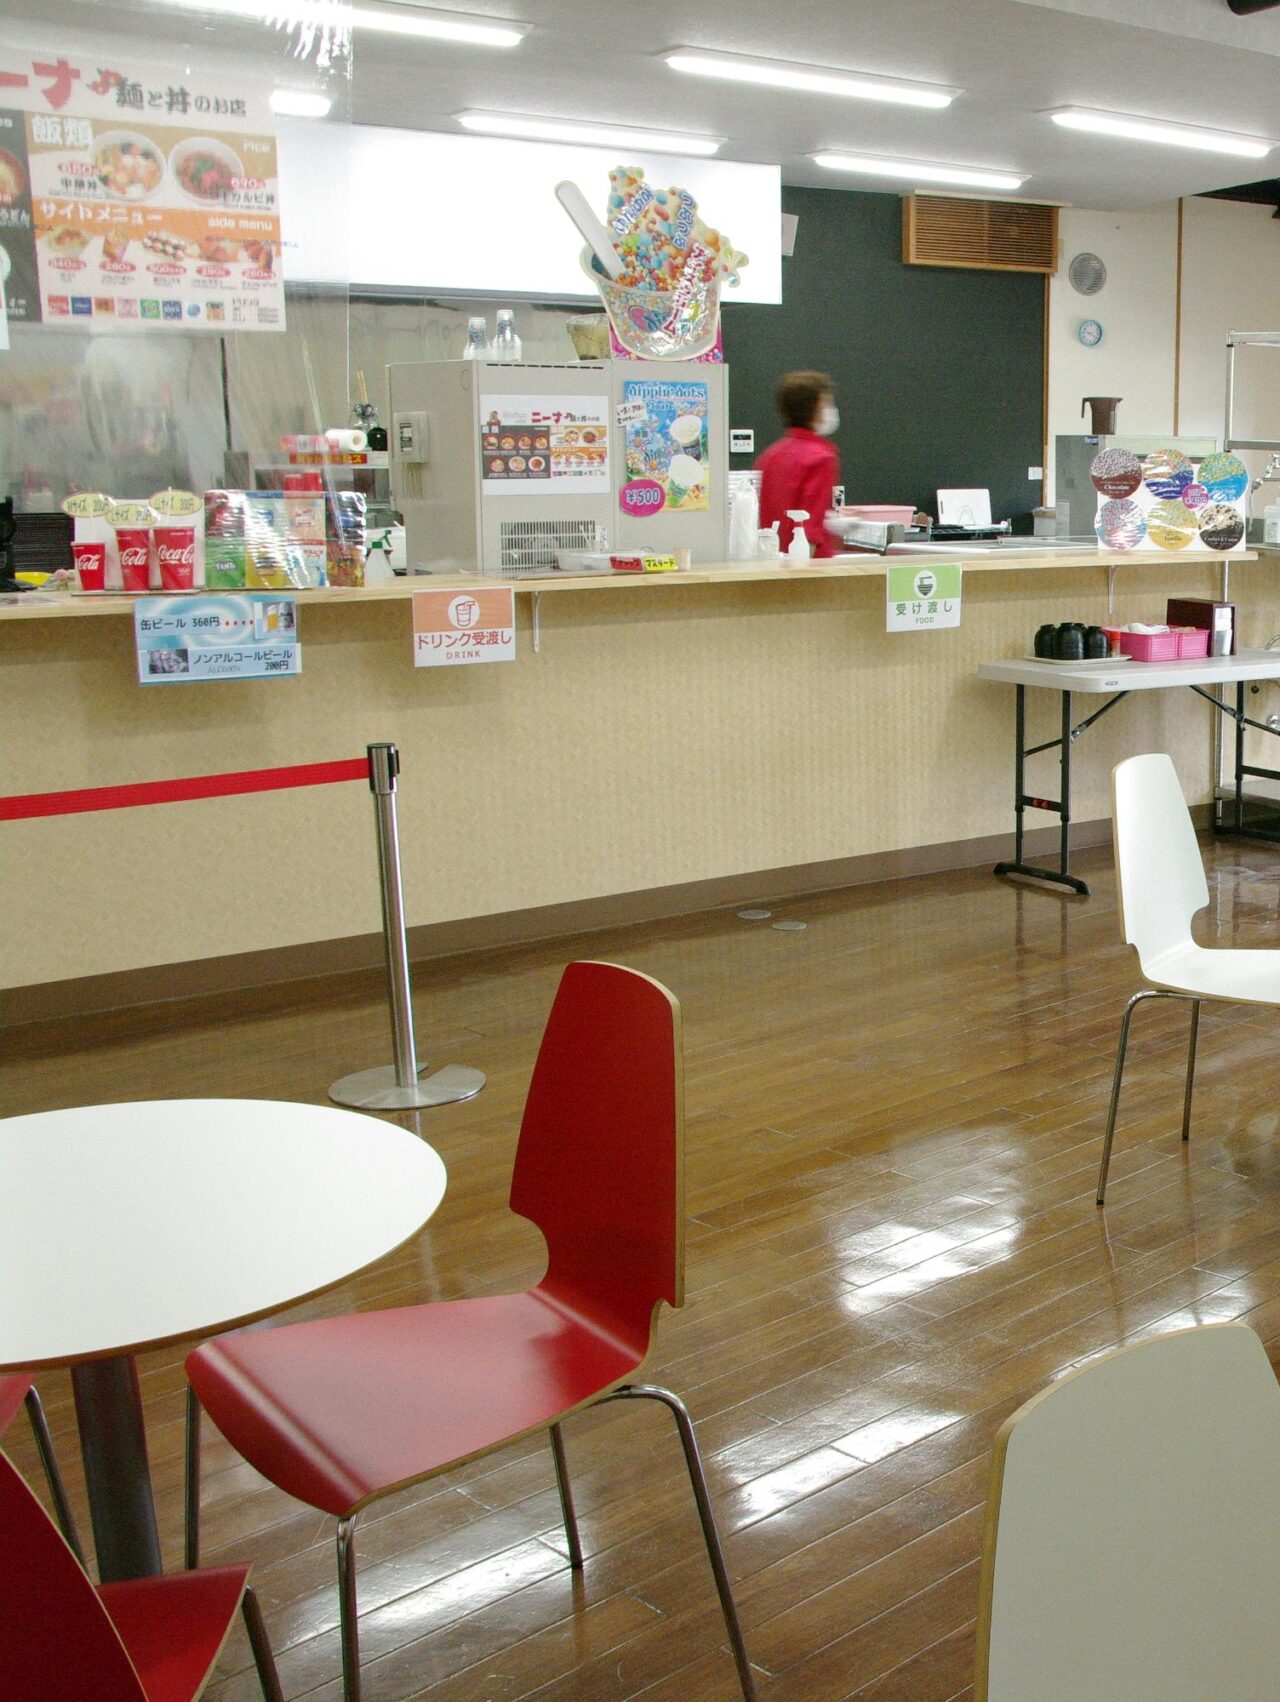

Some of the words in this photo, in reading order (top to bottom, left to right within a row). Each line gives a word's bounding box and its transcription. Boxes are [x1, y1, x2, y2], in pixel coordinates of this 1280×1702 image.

[116, 83, 247, 117] 麺と丼のお店
[40, 201, 163, 224] サイドメニュー
[239, 220, 272, 231] menu
[676, 385, 705, 398] dots
[531, 411, 563, 424] ニーナ
[626, 488, 660, 506] ¥500
[896, 600, 953, 616] 受け渡し
[140, 618, 187, 631] 缶ビール
[191, 616, 220, 628] 360円
[915, 616, 935, 625] FOOD
[418, 630, 512, 650] ドリンク受渡し
[193, 650, 293, 664] ノンアルコールビール
[446, 650, 480, 660] DRINK
[264, 660, 289, 671] 200円
